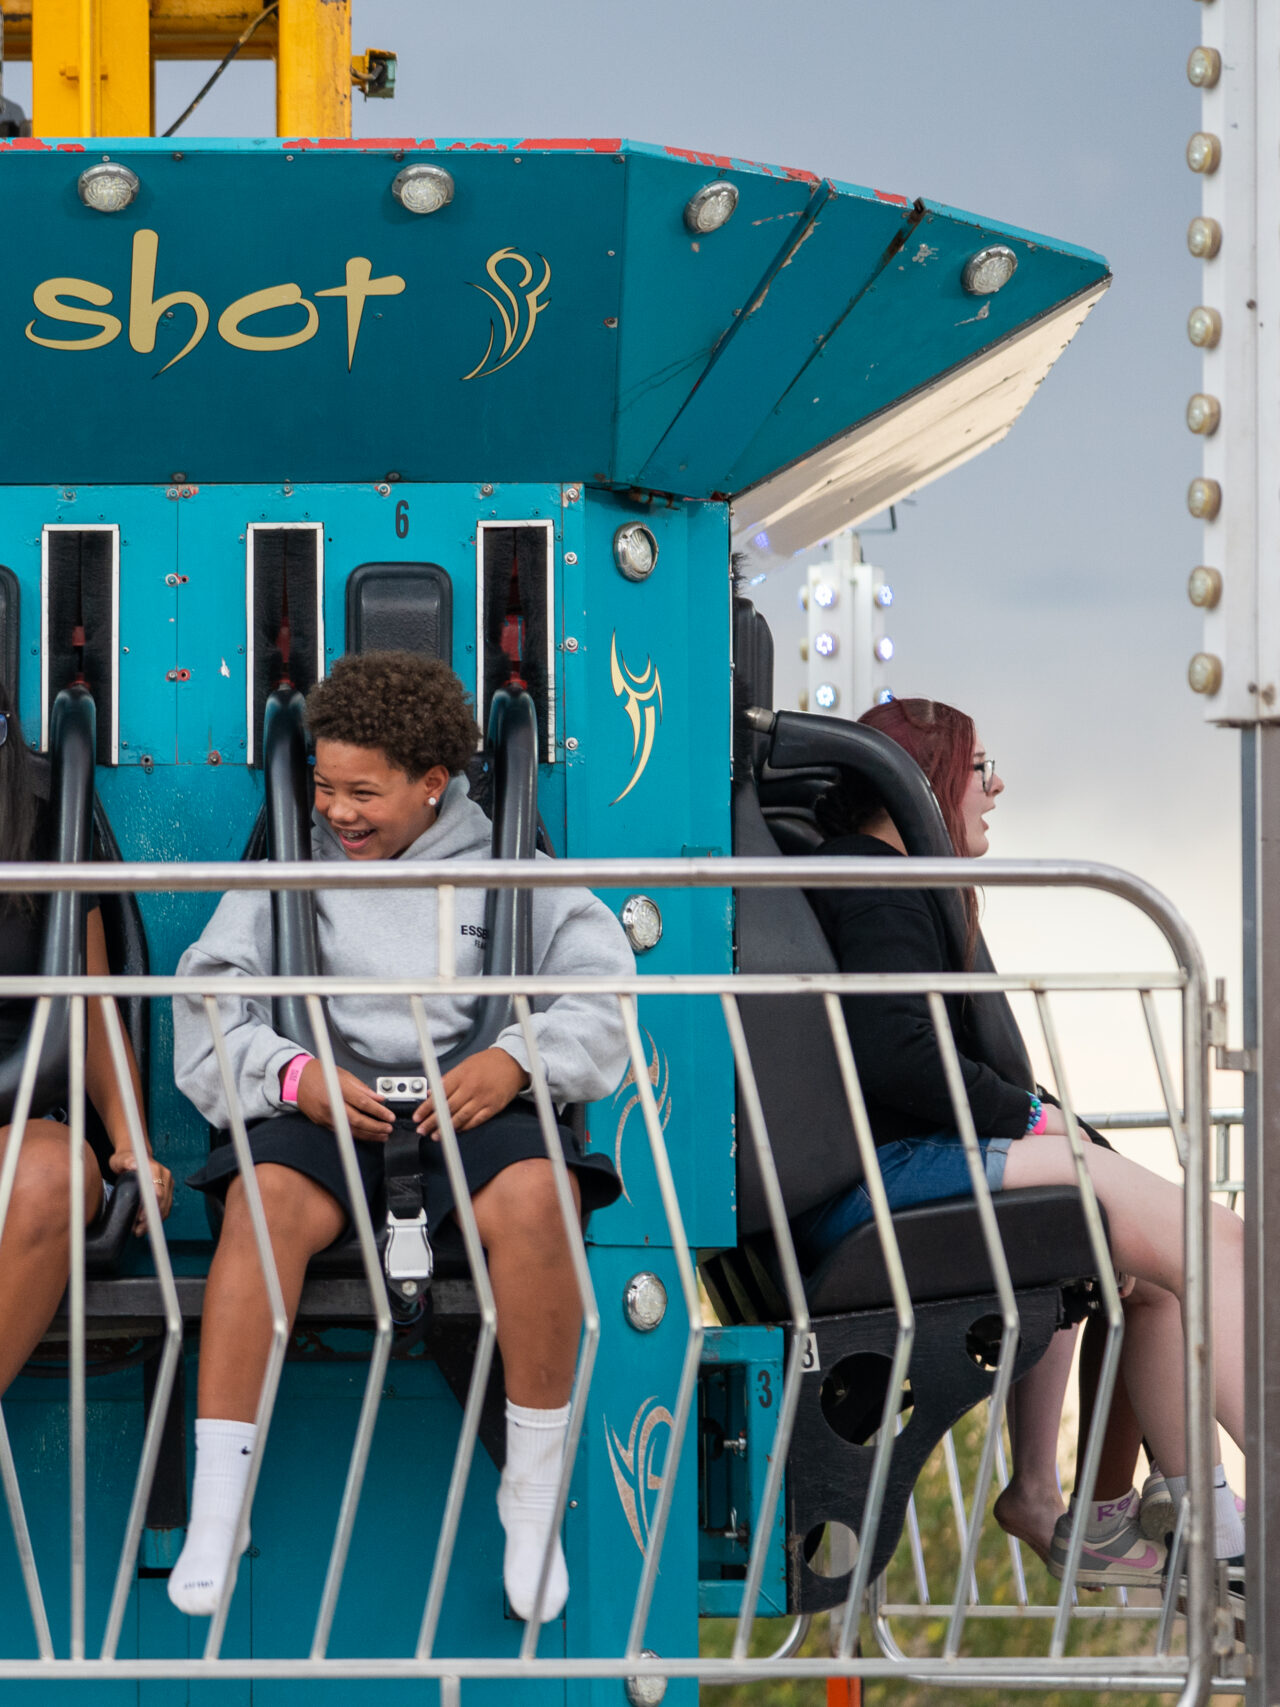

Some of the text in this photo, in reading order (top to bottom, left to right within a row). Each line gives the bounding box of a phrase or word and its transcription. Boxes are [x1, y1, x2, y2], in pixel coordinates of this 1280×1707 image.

[25, 229, 406, 379] shot
[396, 500, 409, 539] 6
[801, 1337, 814, 1369] 3
[758, 1370, 773, 1408] 3
